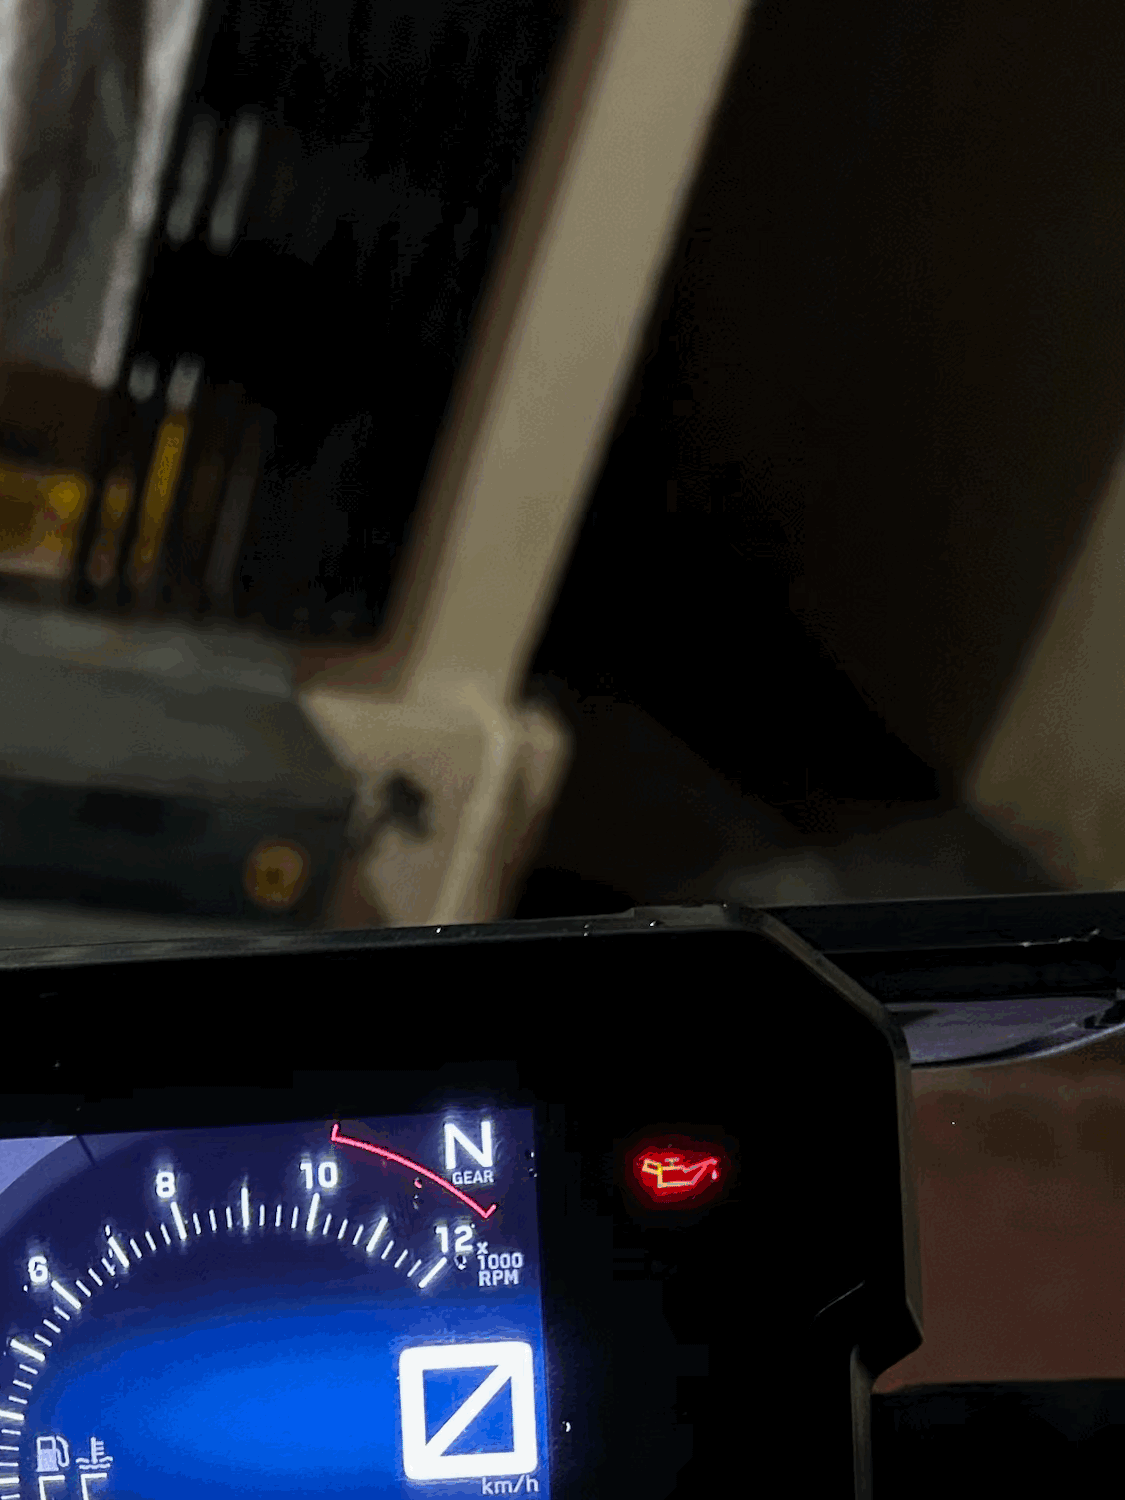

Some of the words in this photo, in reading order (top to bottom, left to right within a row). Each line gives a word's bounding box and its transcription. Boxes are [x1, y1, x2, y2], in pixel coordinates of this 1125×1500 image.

[444, 1121, 493, 1169] N
[156, 1170, 175, 1199] 8
[300, 1162, 339, 1189] 10
[452, 1170, 494, 1185] GEAR
[436, 1225, 474, 1253] 12
[28, 1256, 48, 1284] 6
[477, 1252, 524, 1271] 1000
[478, 1269, 520, 1287] RPM
[481, 1474, 539, 1495] km/h
